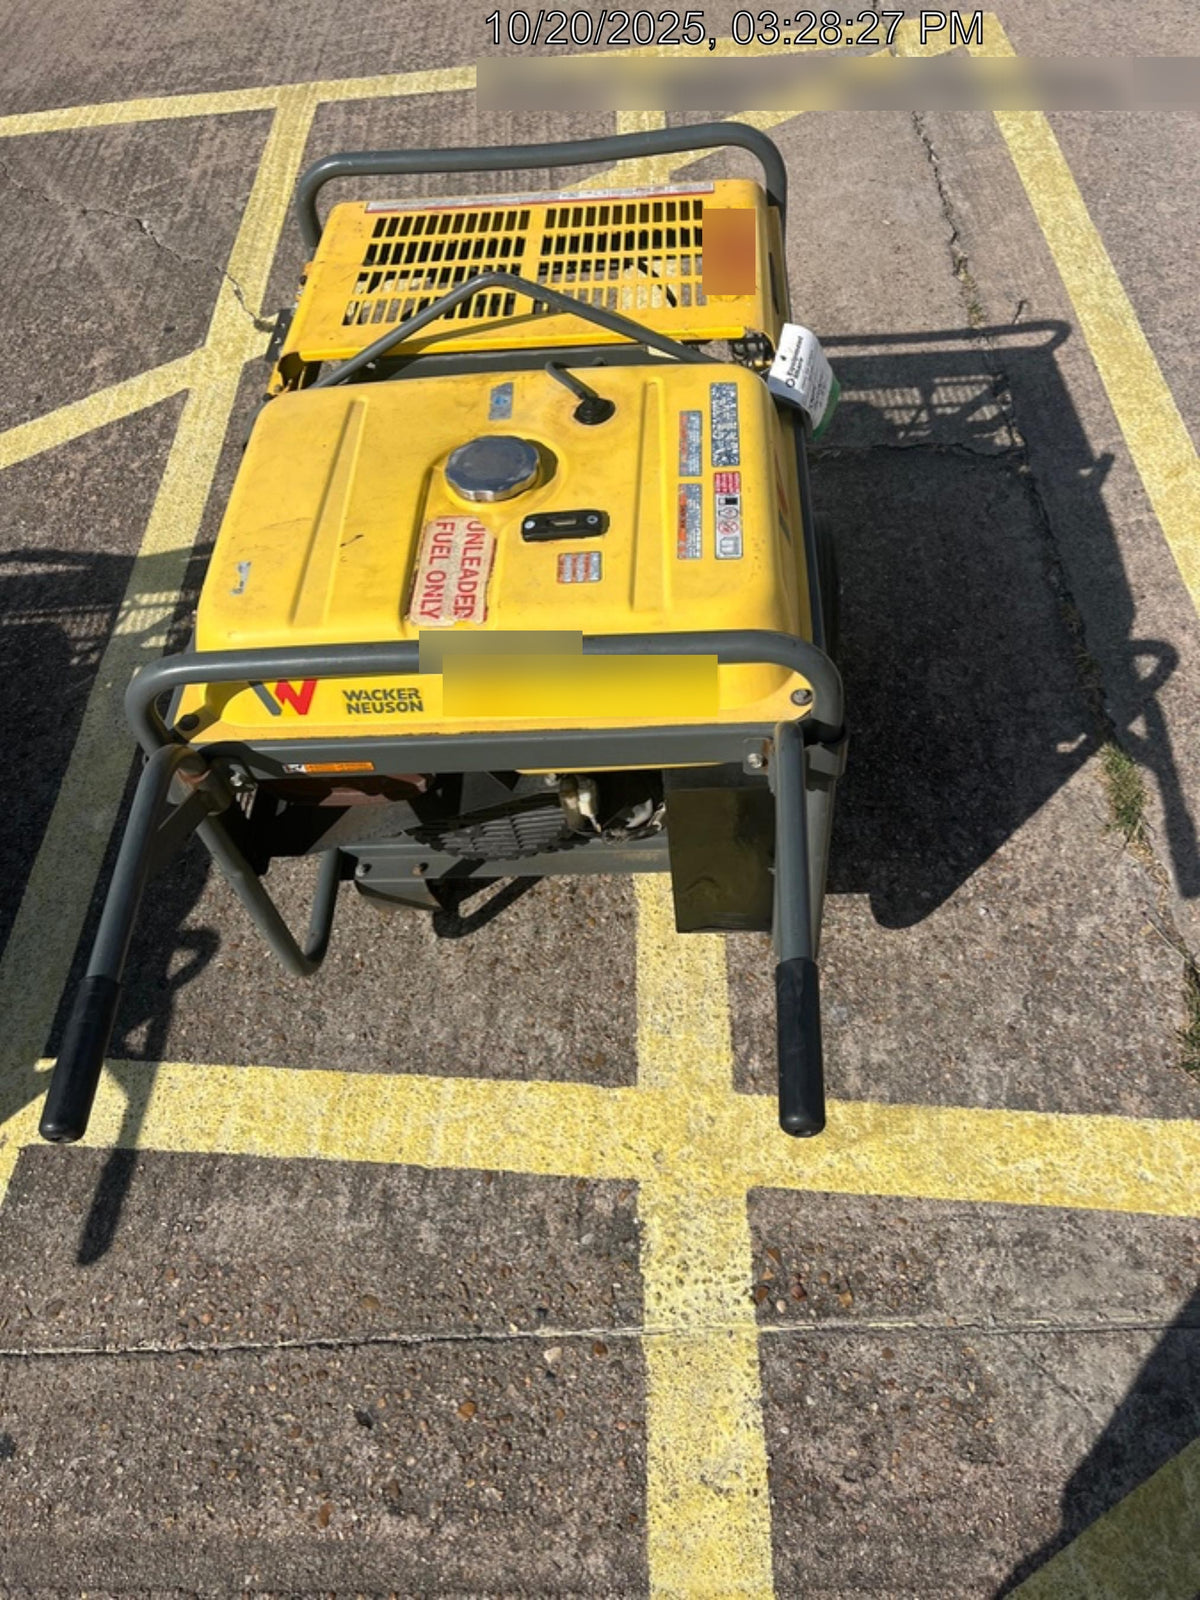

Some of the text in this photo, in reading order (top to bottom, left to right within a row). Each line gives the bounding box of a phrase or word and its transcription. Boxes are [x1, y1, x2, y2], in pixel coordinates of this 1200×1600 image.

[419, 521, 456, 620] FUEL ONLY
[342, 687, 421, 701] WACKER
[346, 701, 424, 714] NEUSON
